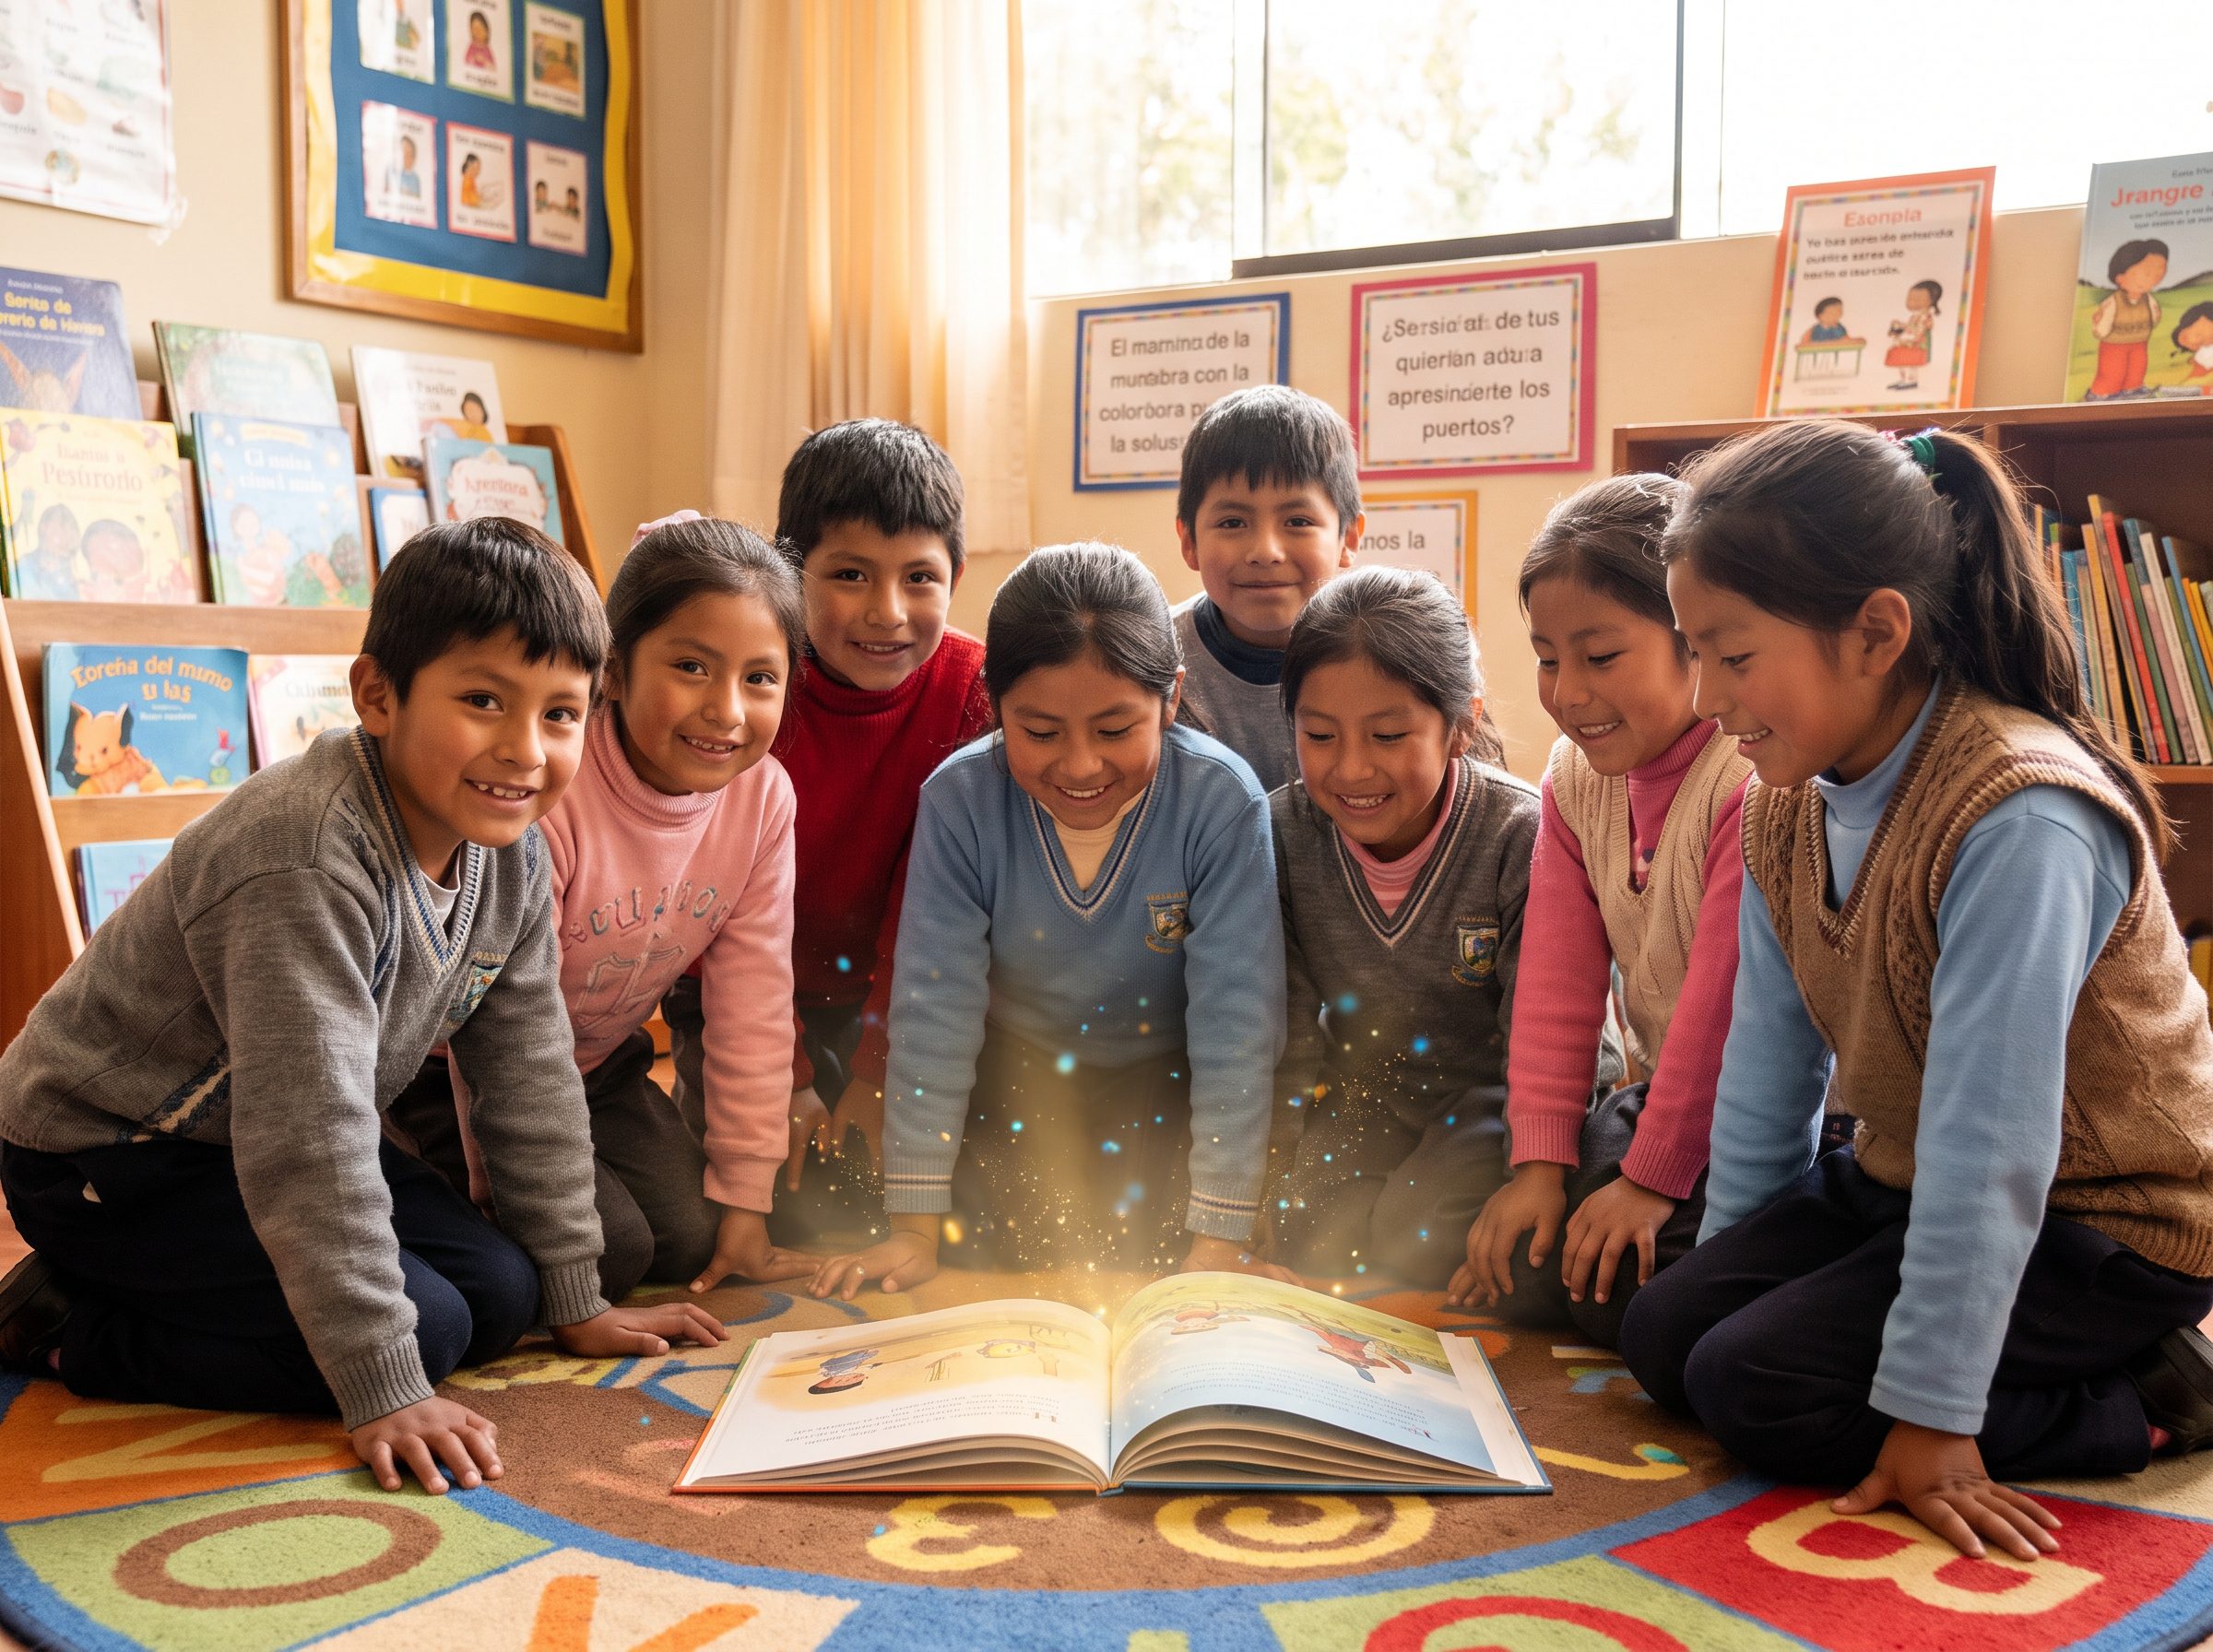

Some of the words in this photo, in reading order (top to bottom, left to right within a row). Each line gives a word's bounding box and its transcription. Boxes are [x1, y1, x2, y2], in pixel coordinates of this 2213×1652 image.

[1496, 311, 1521, 330] de
[1528, 309, 1560, 327] tus
[1110, 337, 1127, 358] El
[1206, 331, 1229, 349] de
[1234, 329, 1250, 348] la
[1194, 368, 1227, 384] con
[1233, 363, 1249, 382] la
[1521, 380, 1550, 398] los
[1423, 414, 1515, 443] puertos?
[1110, 434, 1127, 454] la
[1359, 533, 1402, 550] nos
[1407, 529, 1426, 550] la
[145, 655, 174, 676] del
